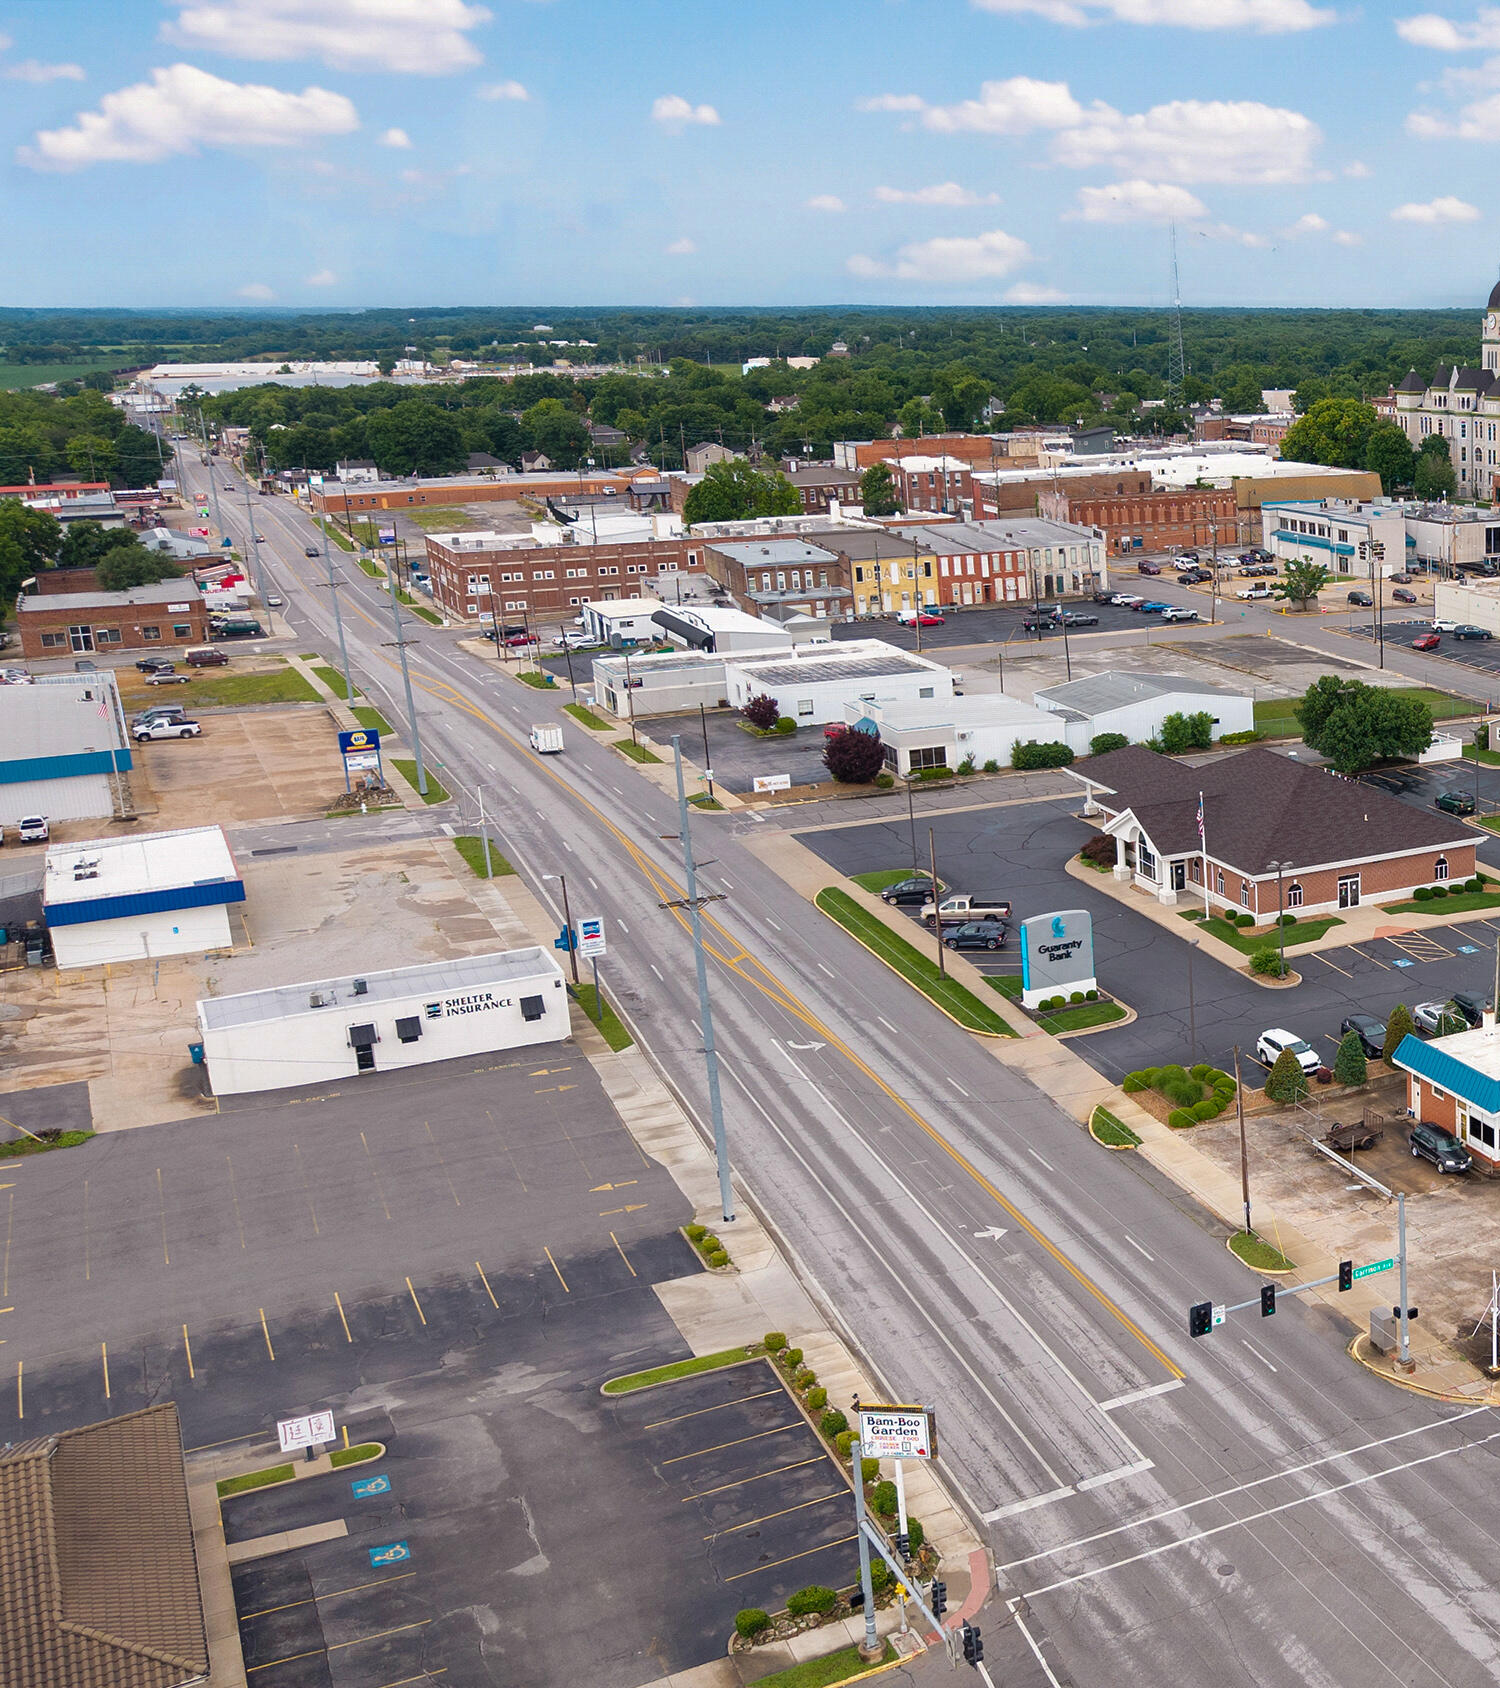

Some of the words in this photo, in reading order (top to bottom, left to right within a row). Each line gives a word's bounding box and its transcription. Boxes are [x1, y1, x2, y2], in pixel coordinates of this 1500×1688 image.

[1038, 940, 1082, 954] Guaranty
[1049, 949, 1072, 962] Bank
[445, 993, 493, 1008] SHELTER
[446, 998, 513, 1017] INSURANCE
[867, 1416, 920, 1427] Bam-Boo
[871, 1425, 918, 1436] Garden
